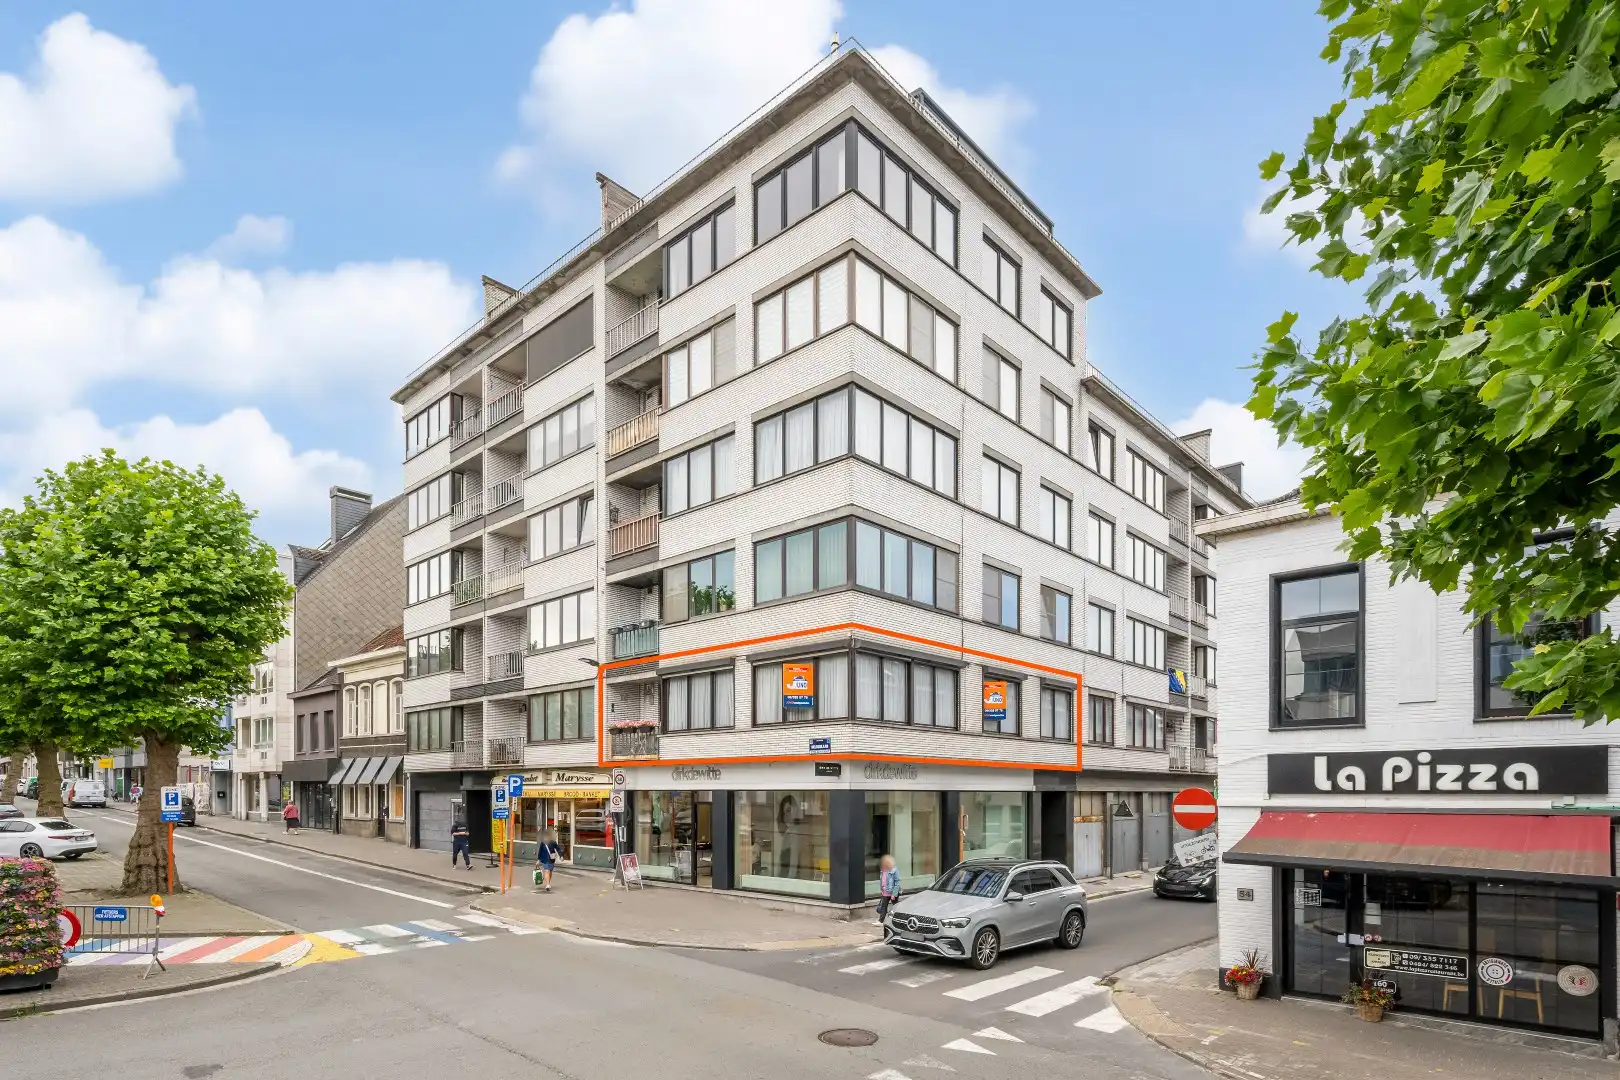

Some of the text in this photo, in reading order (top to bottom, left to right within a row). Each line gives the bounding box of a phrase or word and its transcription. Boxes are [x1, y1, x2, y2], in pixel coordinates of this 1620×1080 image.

[555, 772, 594, 783] Marysse
[1313, 751, 1540, 791] La Pizza
[510, 777, 521, 792] P
[1239, 890, 1251, 898] 54
